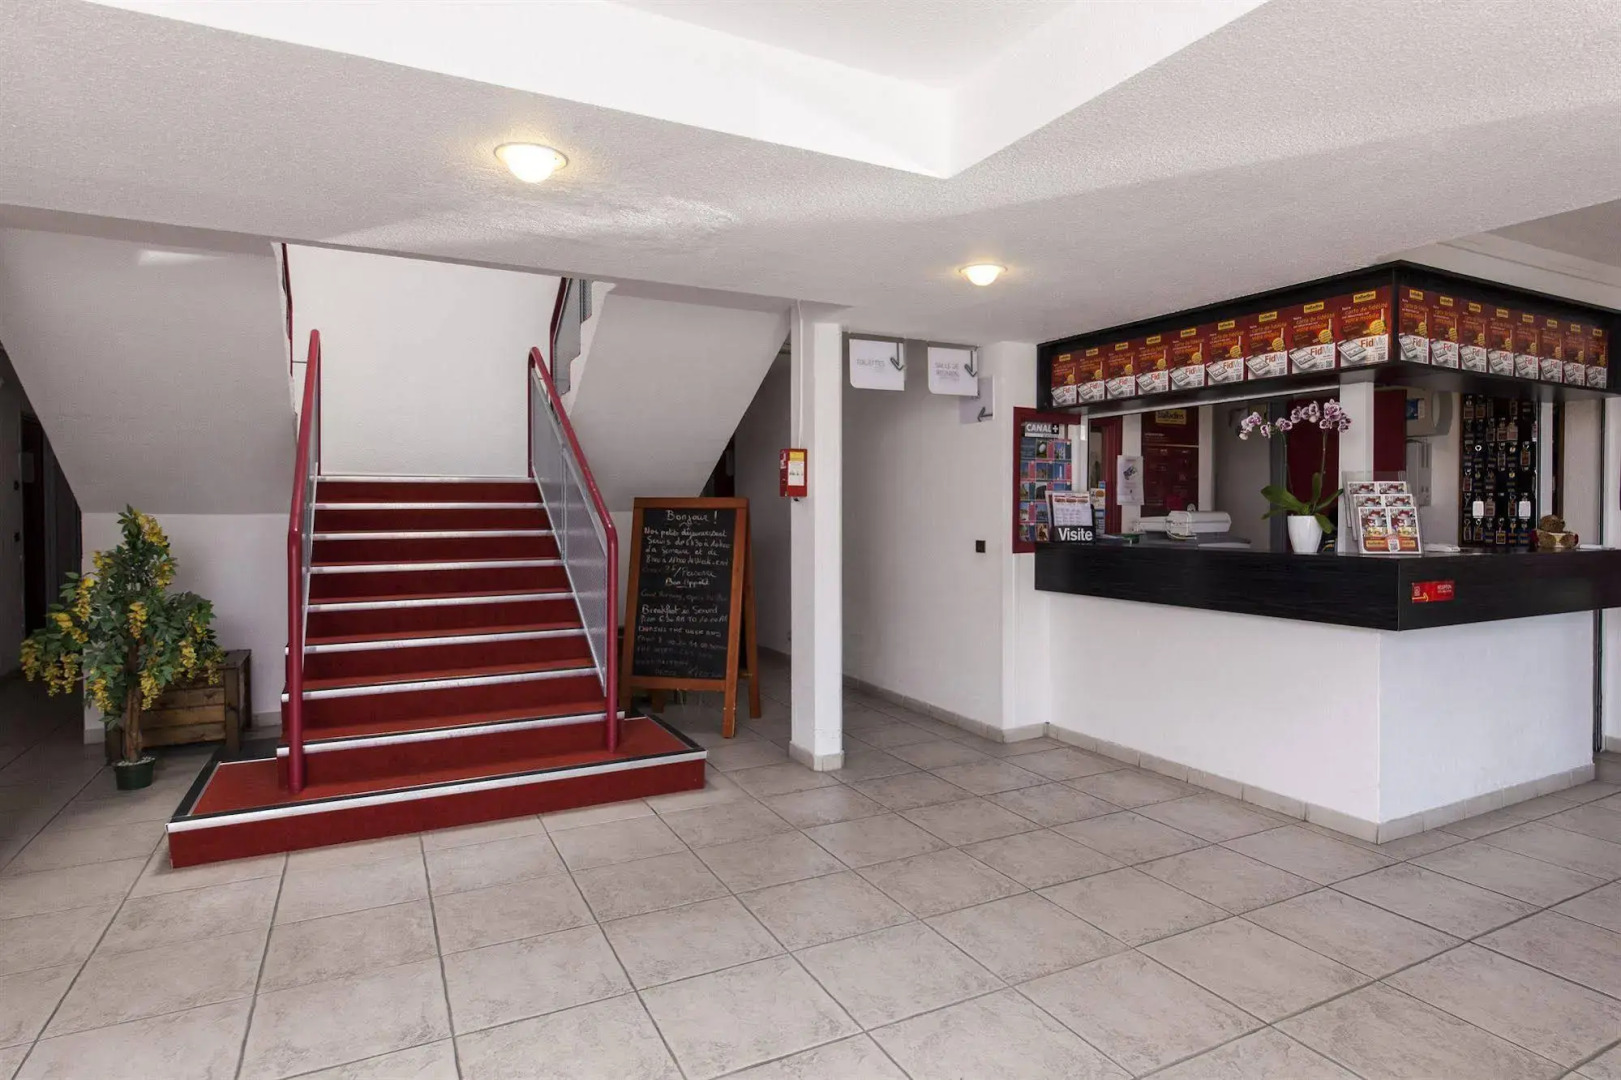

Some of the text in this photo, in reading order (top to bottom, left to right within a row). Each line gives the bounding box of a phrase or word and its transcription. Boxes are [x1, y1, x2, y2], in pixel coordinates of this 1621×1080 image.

[1026, 424, 1059, 433] CANAL+
[666, 510, 709, 527] Bonjour
[1058, 527, 1093, 541] Visite
